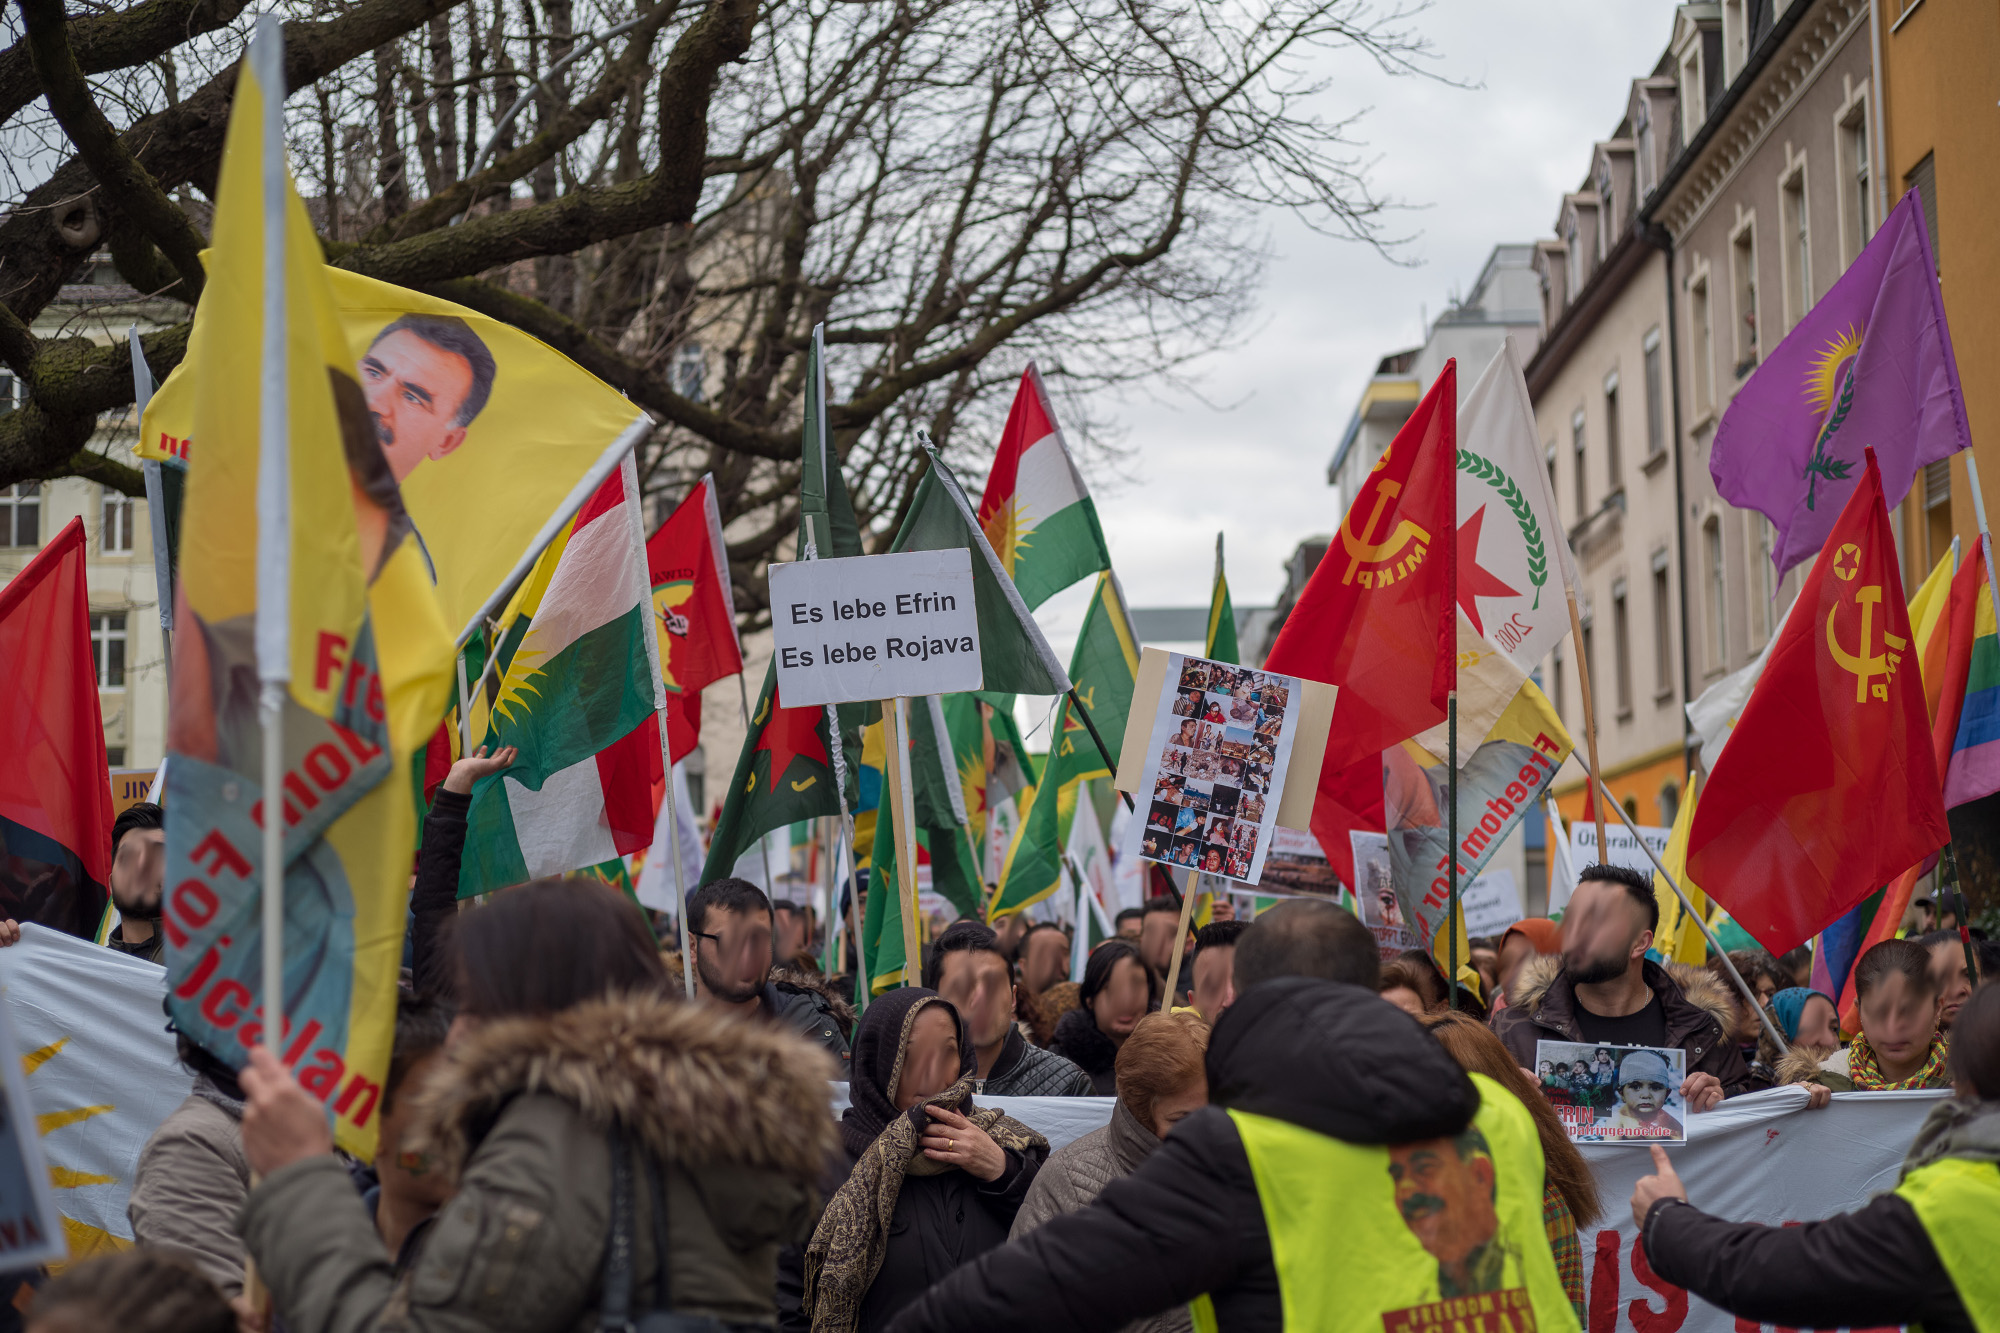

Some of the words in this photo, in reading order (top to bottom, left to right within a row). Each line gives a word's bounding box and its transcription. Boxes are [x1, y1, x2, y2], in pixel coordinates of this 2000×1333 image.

[790, 603, 824, 625] Es
[832, 598, 887, 621] lebe
[895, 591, 957, 616] Efrin
[781, 647, 814, 669] Es
[823, 642, 877, 665] lebe
[886, 635, 975, 662] Rojava
[1553, 1104, 1594, 1125] FRIN
[1566, 1123, 1671, 1138] pafringenocide
